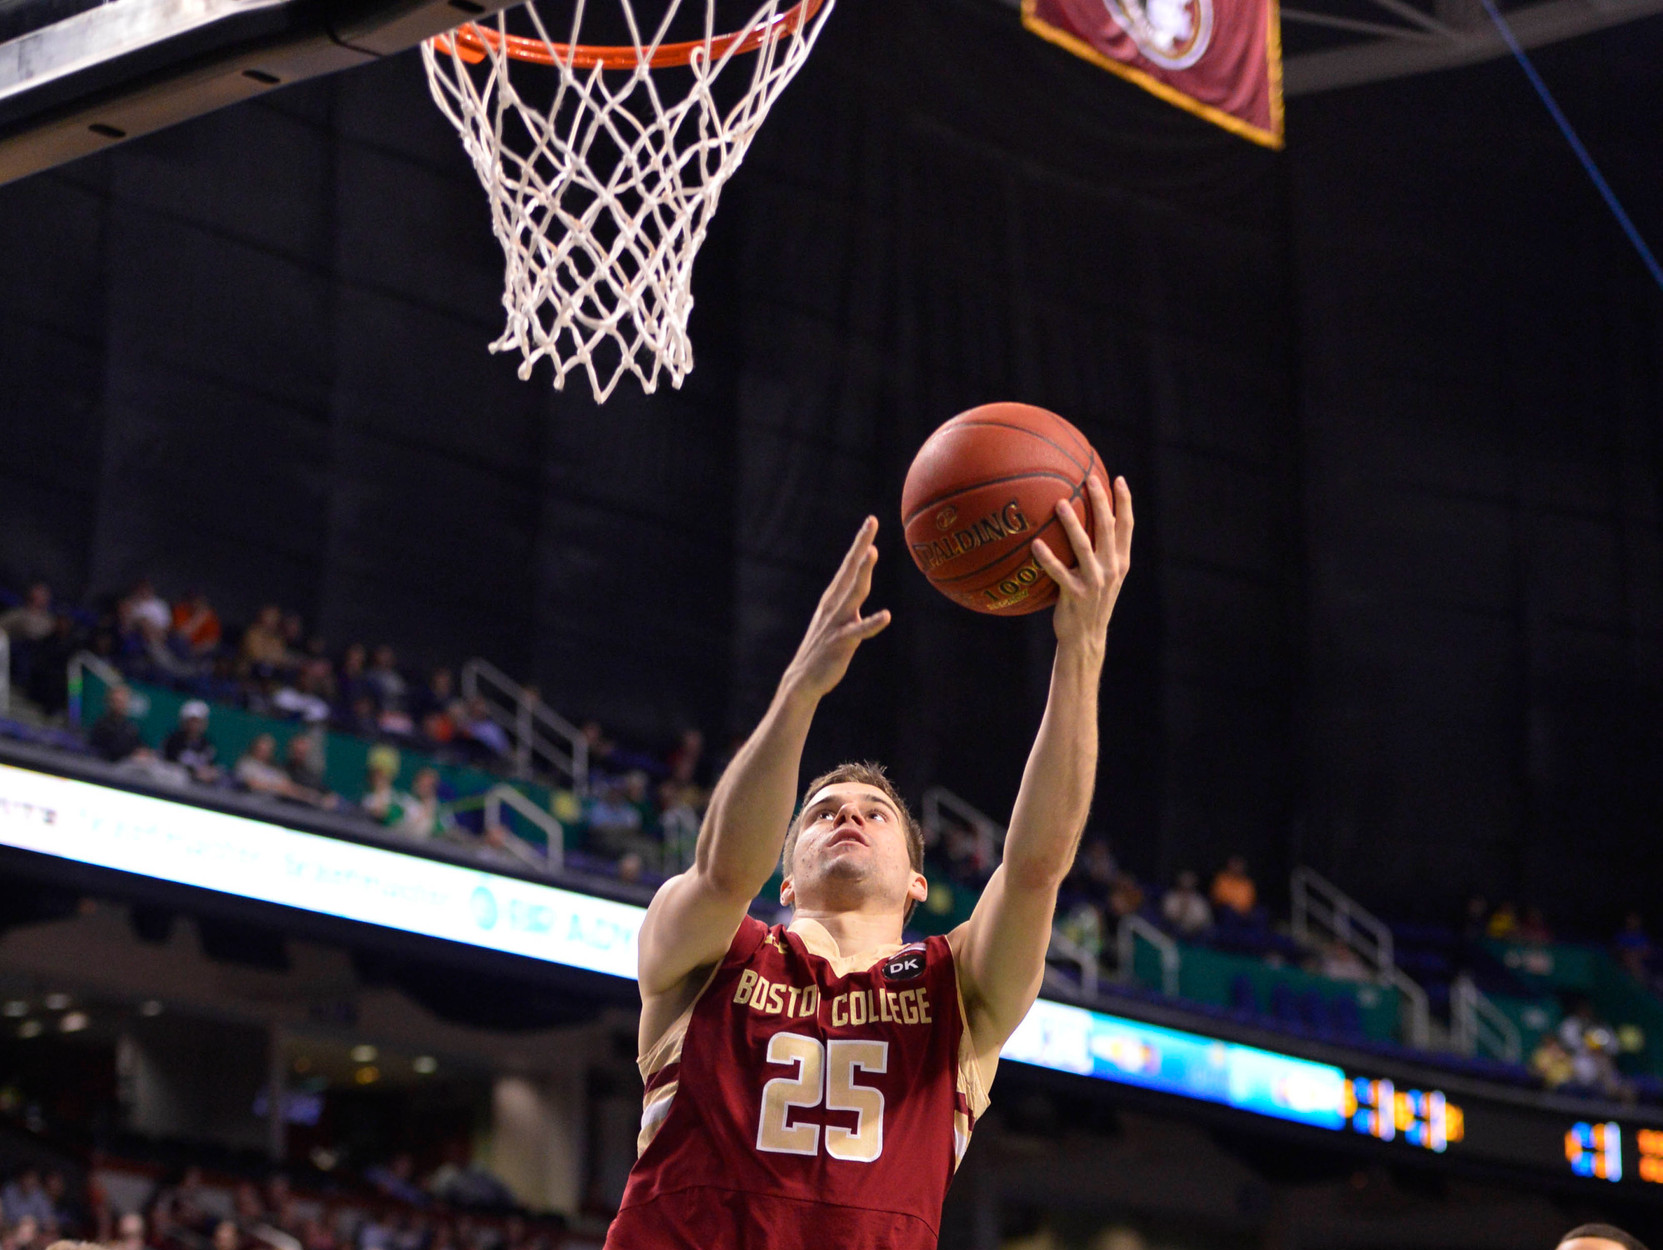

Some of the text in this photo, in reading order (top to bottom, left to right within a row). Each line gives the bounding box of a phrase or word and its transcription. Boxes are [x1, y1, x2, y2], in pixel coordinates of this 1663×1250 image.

[914, 498, 1030, 573] PALDING
[733, 968, 932, 1028] BOSTO COLLEGE
[890, 958, 919, 974] DK
[756, 1031, 889, 1162] 25
